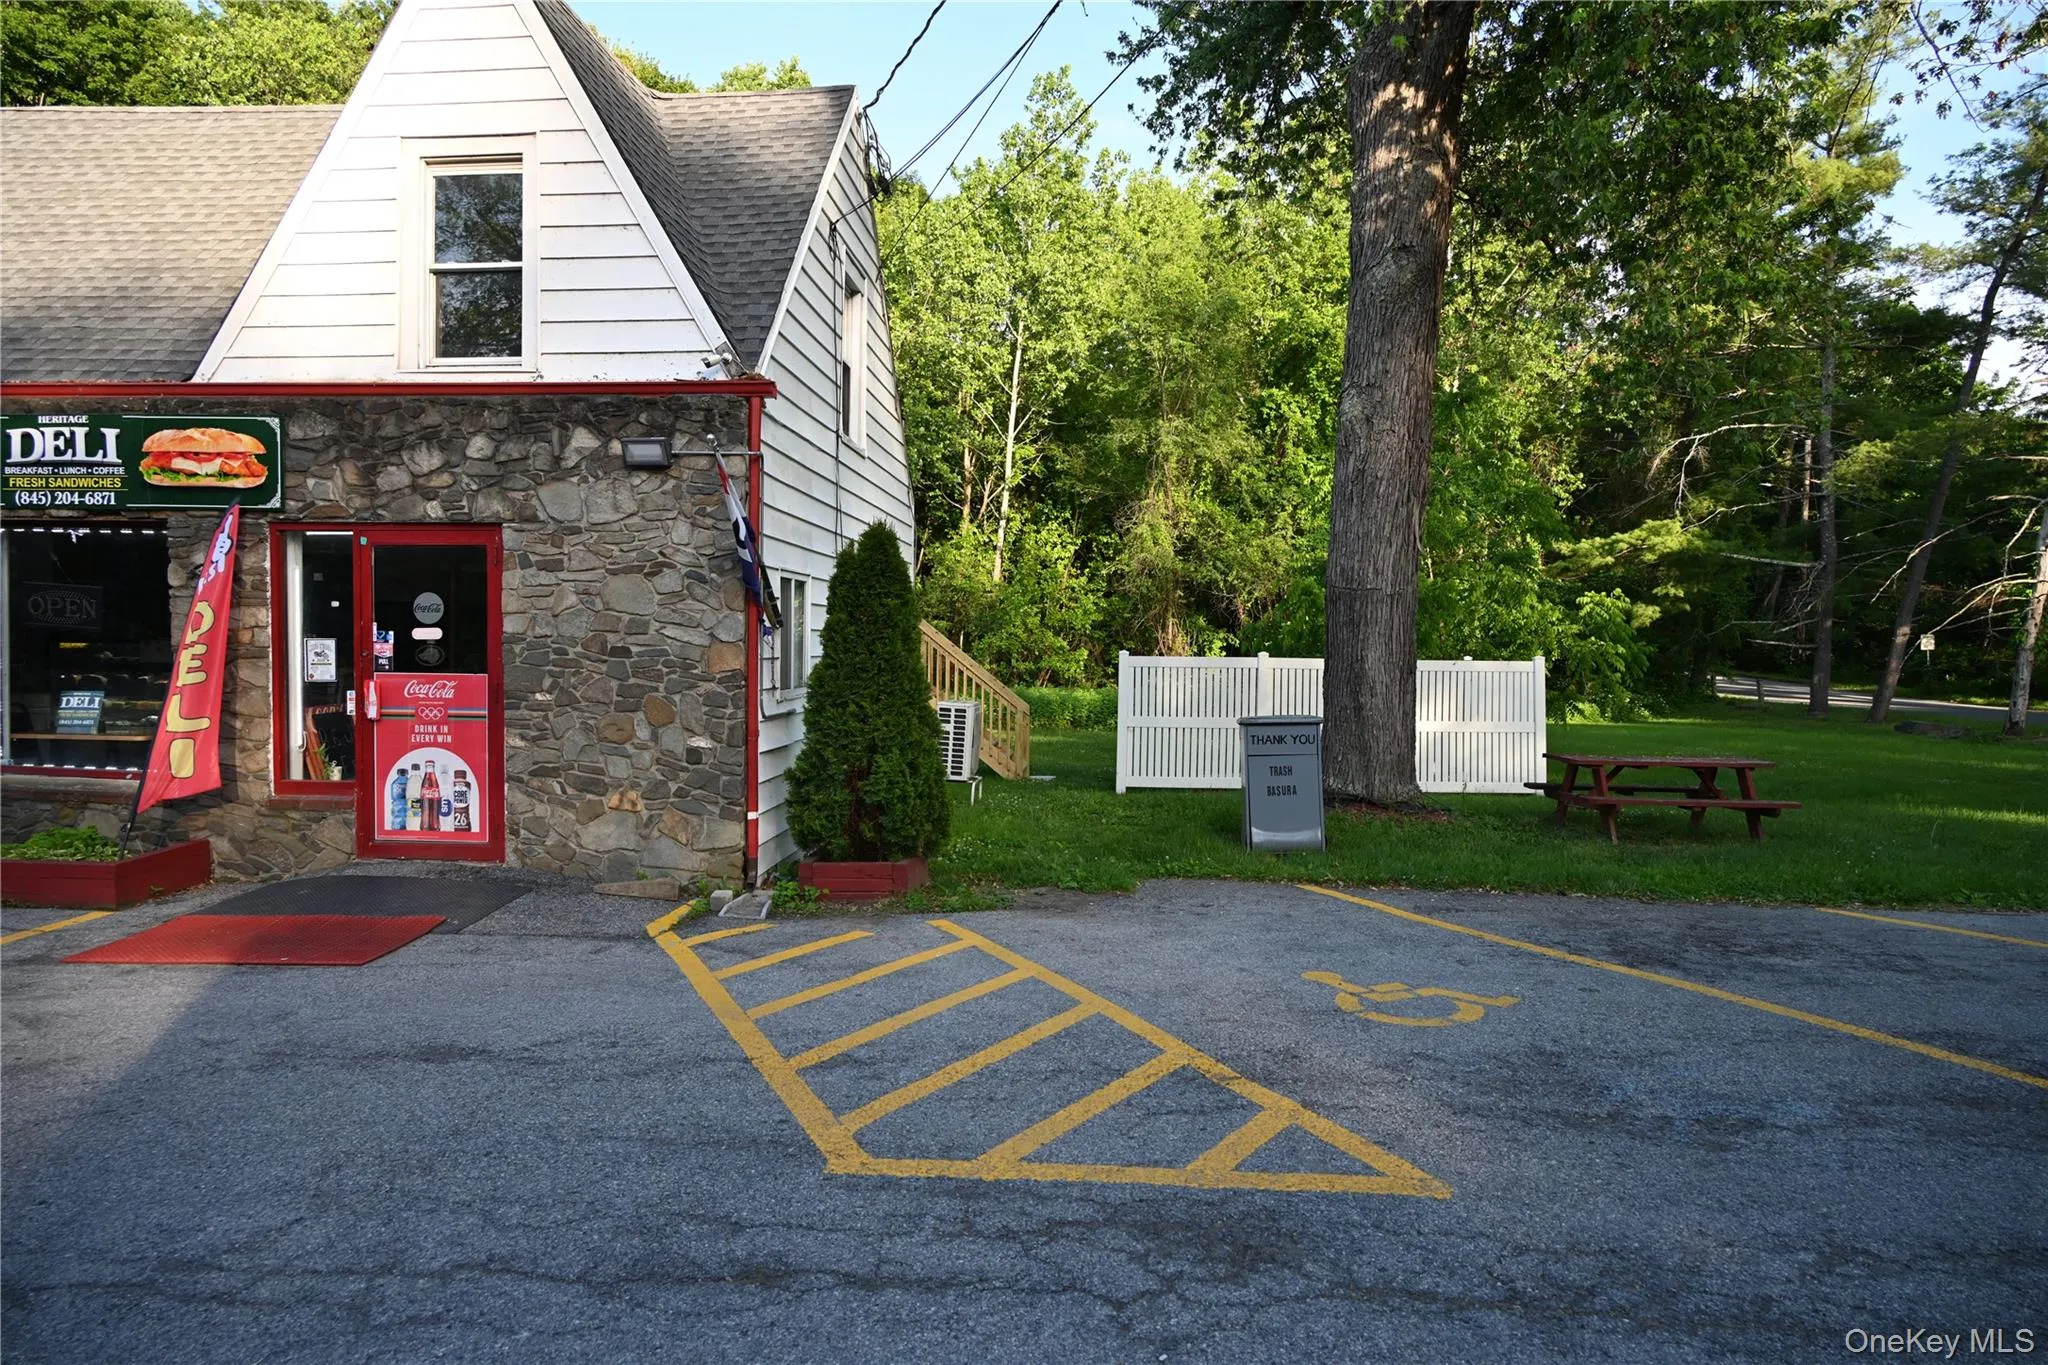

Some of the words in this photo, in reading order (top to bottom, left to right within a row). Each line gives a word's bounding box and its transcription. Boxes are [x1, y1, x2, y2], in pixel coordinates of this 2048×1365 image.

[38, 415, 89, 424] HERITAGE
[6, 426, 122, 464] DELI
[4, 466, 53, 475] BREAKFAST
[59, 466, 87, 475] LUNCH
[92, 466, 125, 475] COFFEE
[9, 477, 46, 488] FRESH
[48, 477, 122, 488] SANDWICHES
[15, 490, 51, 506] (845)
[54, 491, 117, 506] 204-6871
[28, 595, 97, 618] OPEN
[166, 601, 216, 779] DELI
[404, 680, 458, 698] Coca-Cola
[60, 696, 101, 709] DELI
[414, 724, 438, 734] DRINK
[440, 725, 449, 734] IN
[411, 734, 434, 743] EVERY
[437, 735, 452, 743] WIN
[1250, 734, 1288, 745] THANK
[1290, 734, 1316, 745] YOU
[1269, 765, 1293, 777] TRASH
[453, 790, 468, 799] CORE
[1266, 785, 1297, 797] BASURA
[454, 813, 467, 826] 26
